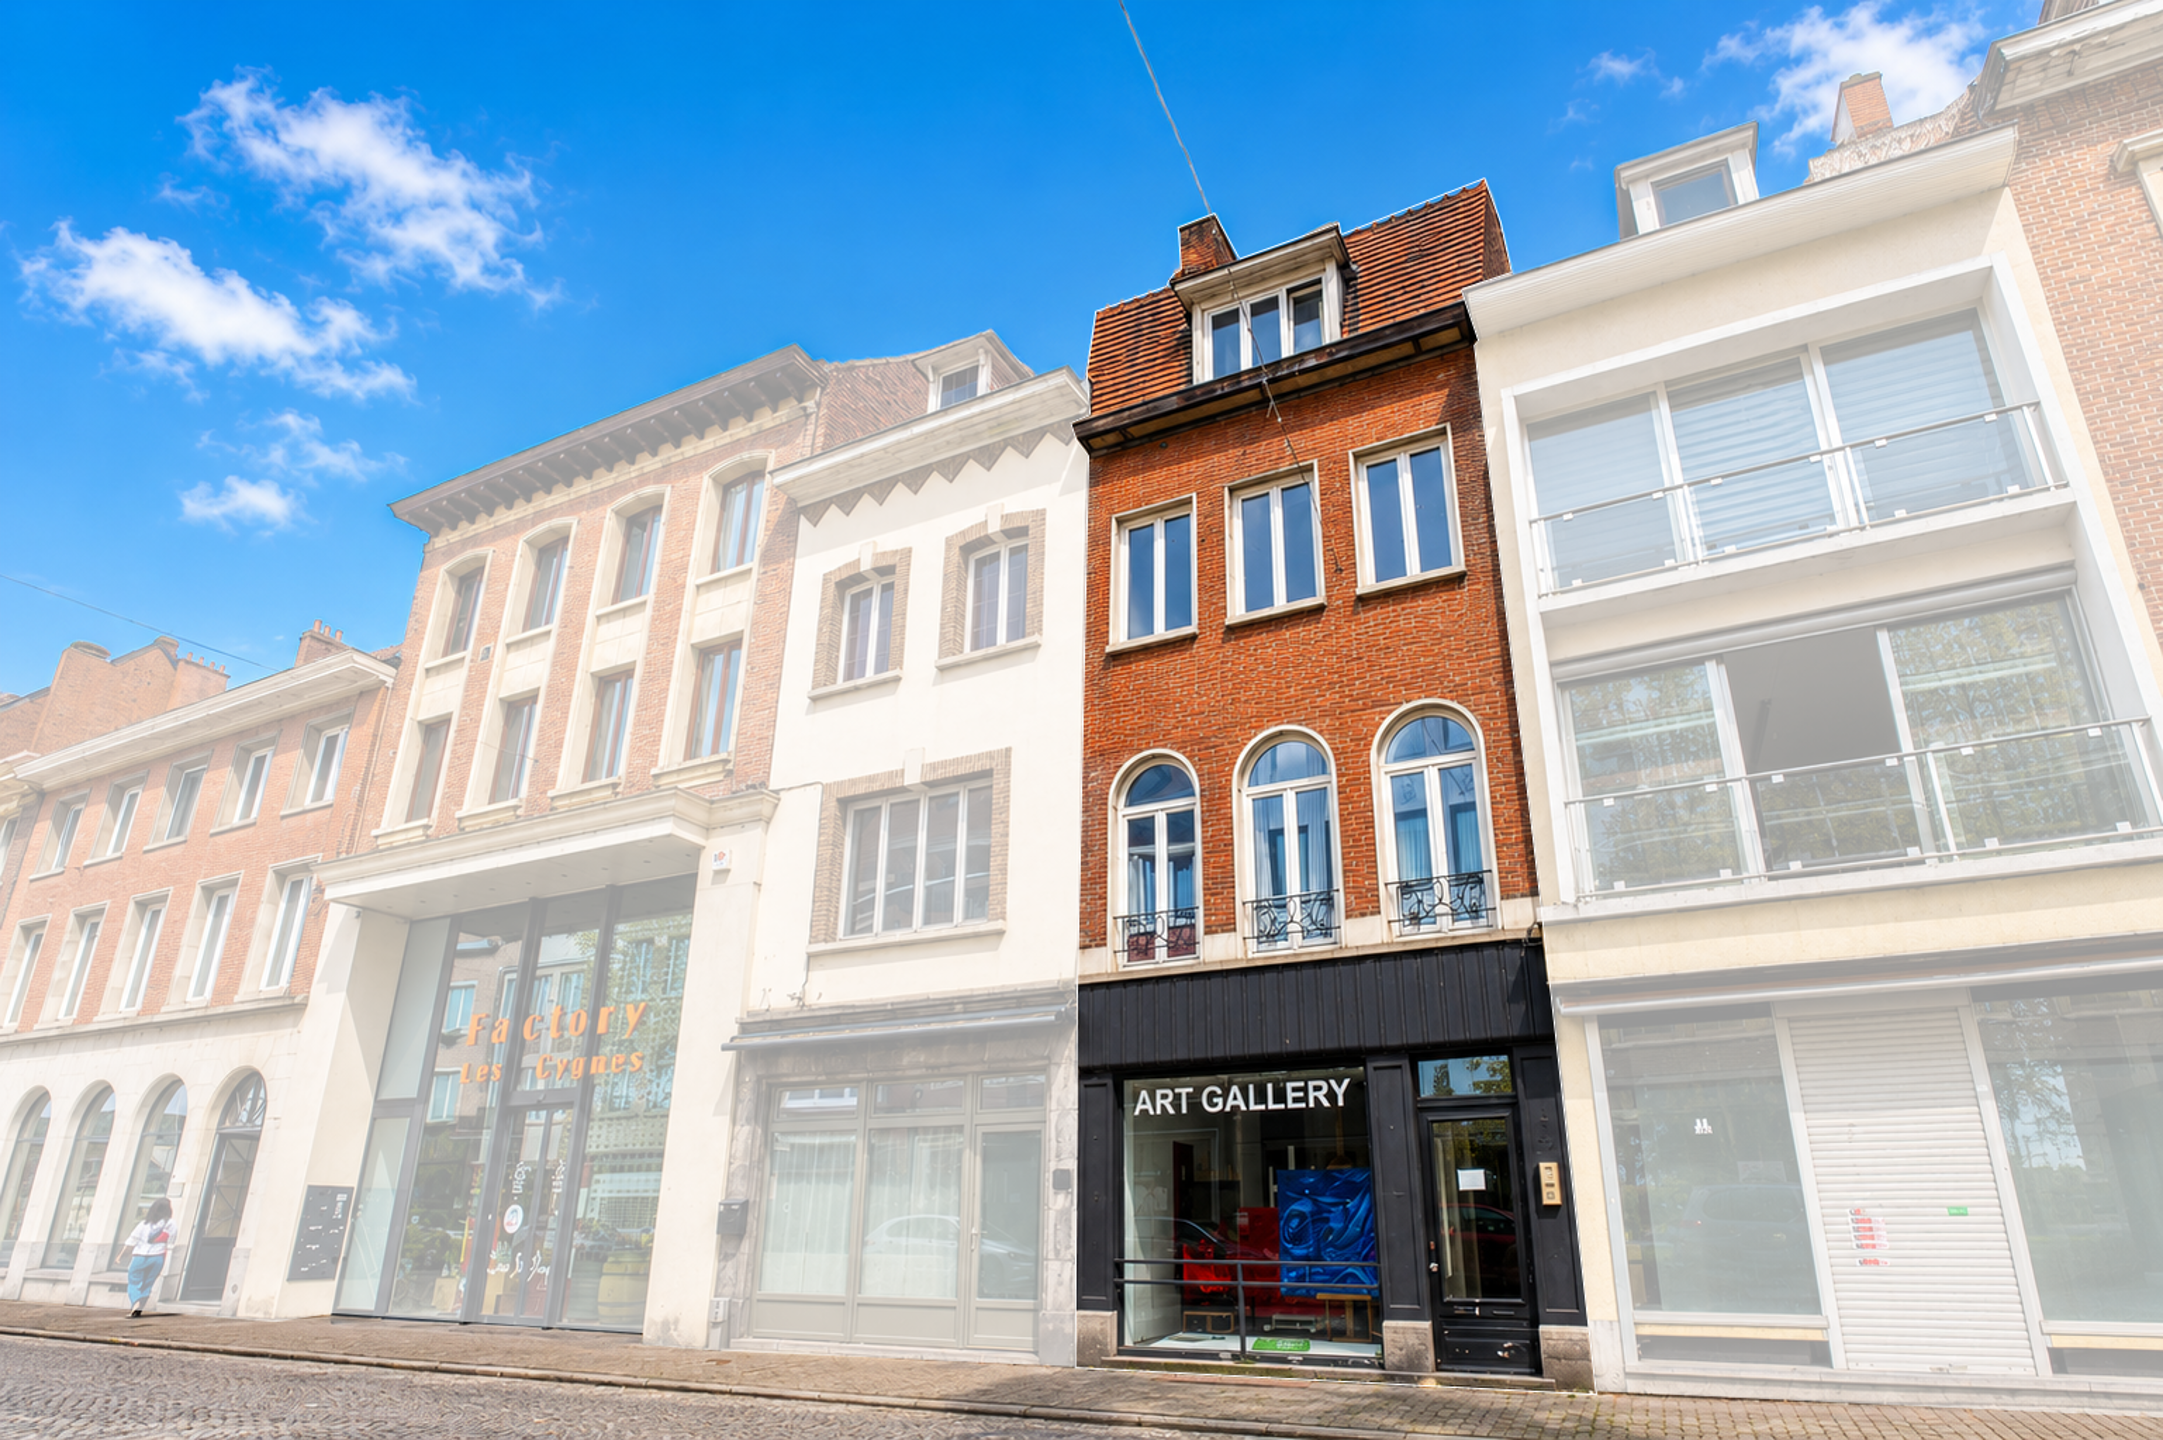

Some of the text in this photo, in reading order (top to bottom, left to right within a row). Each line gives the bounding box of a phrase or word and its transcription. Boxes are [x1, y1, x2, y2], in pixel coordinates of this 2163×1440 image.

[466, 1002, 648, 1046] Factory
[460, 1051, 644, 1084] Les Cygnes
[1134, 1078, 1351, 1115] ART GALLERY
